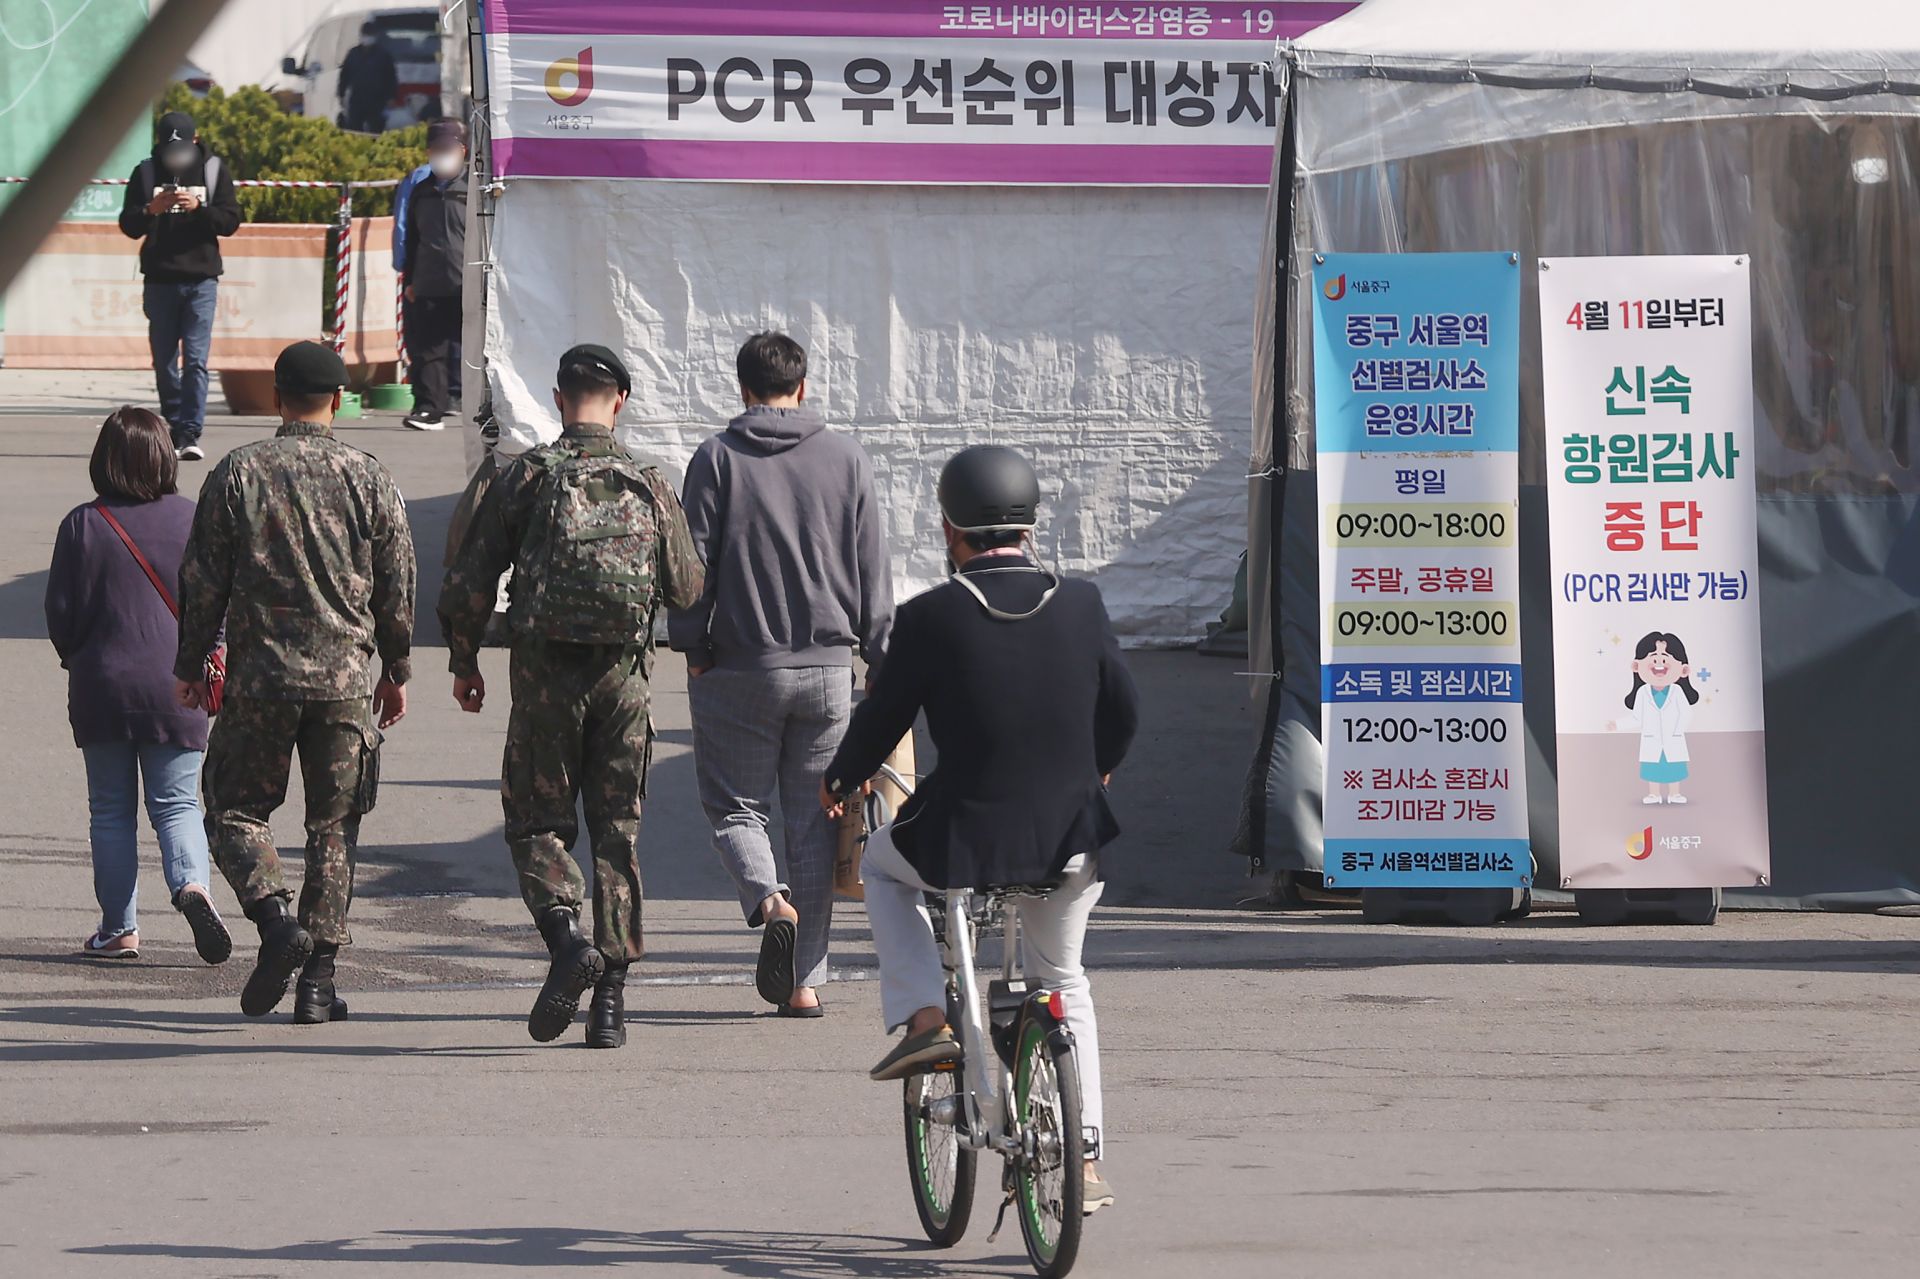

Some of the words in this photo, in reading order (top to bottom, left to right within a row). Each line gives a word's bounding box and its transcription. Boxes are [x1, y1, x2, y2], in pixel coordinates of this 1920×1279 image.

[939, 5, 1213, 36] 코로나바이러스감염증
[1241, 9, 1275, 34] 19
[666, 57, 816, 124] PCR
[842, 57, 1075, 126] 우선순위
[1103, 60, 1281, 127] 대상자
[545, 114, 594, 131] 서울중구
[1351, 280, 1391, 294] 서울중구
[1566, 300, 1609, 331] 4월
[1618, 297, 1725, 330] 11일부터
[1346, 314, 1400, 348] 중구
[1408, 313, 1489, 347] 서울역
[1351, 359, 1487, 391] 선별검사소
[1604, 364, 1692, 416] 신속
[1366, 403, 1475, 436] 운영시간
[1562, 431, 1740, 484] 항원검사
[1395, 469, 1446, 495] 평일
[1336, 512, 1505, 538] 09:00~18:00
[1351, 567, 1409, 595] 주말,
[1417, 567, 1494, 593] 공휴일
[1563, 572, 1622, 603] (PCR
[1627, 572, 1691, 602] 검사만
[1697, 569, 1748, 601] 가능)
[1337, 610, 1507, 636] 09:00~13:00
[1335, 670, 1383, 696] 소독
[1390, 670, 1413, 696] 및
[1420, 669, 1513, 696] 점심시간
[1342, 717, 1507, 743] 12:00~13:00
[1371, 768, 1438, 790] 검사소
[1444, 767, 1509, 790] 혼잡시
[1357, 799, 1447, 821] 조기마감
[1453, 799, 1497, 821] 가능
[1659, 835, 1702, 850] 서울중구
[1341, 852, 1375, 872] 중구
[1380, 851, 1514, 872] 서울역선별검사소
